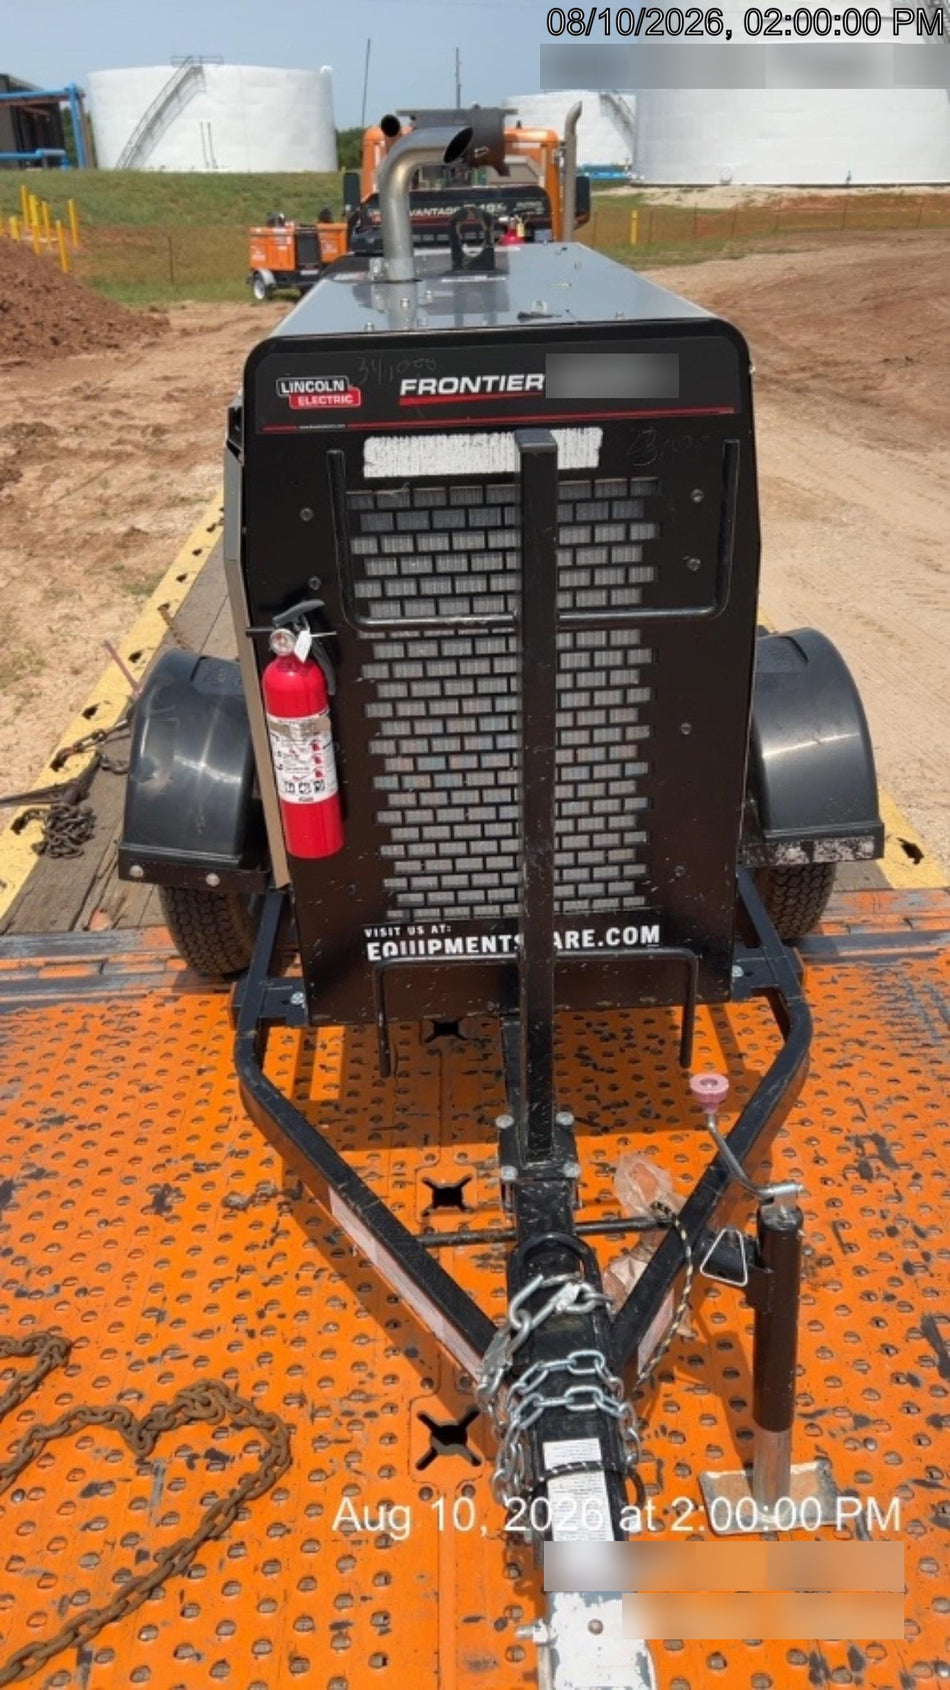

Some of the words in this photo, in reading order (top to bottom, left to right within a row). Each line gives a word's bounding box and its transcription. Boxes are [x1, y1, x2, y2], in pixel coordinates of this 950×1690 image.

[280, 379, 345, 394] LINCOLN
[400, 374, 546, 396] FRONTIER
[297, 394, 353, 407] ELECTRIC
[364, 926, 401, 938] VISIT
[407, 925, 425, 936] US
[431, 924, 452, 935] AT:
[366, 925, 661, 961] EQUIPMENTSARE.COM
